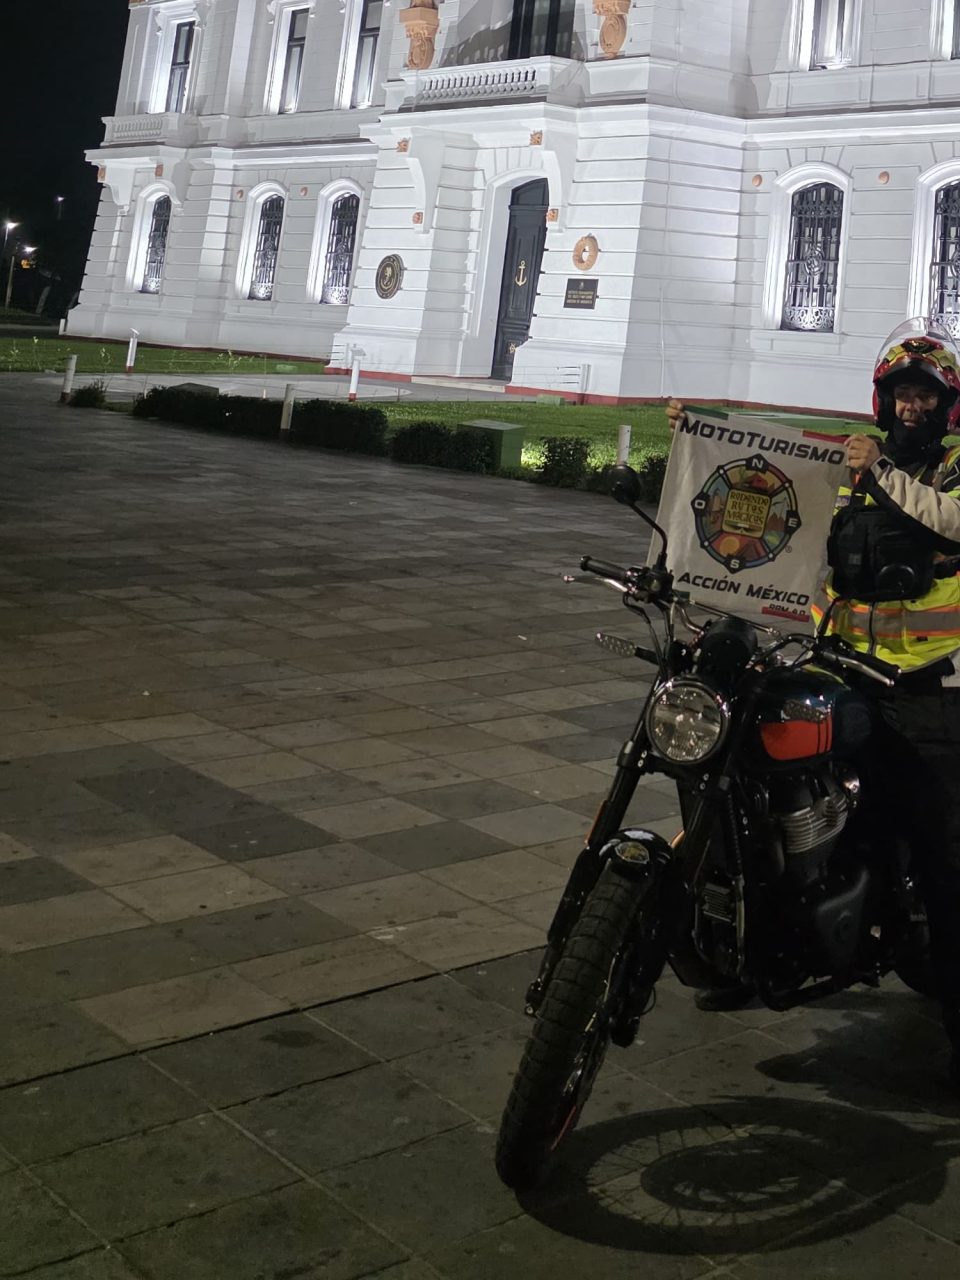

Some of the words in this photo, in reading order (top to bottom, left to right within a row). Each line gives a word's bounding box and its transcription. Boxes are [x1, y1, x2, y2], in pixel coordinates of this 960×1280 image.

[679, 419, 846, 465] MOTOTURISMO
[751, 458, 764, 468] N
[787, 518, 798, 528] E
[729, 559, 740, 569] S
[677, 572, 741, 594] ACCIÓN
[746, 583, 810, 607] MÉXICO
